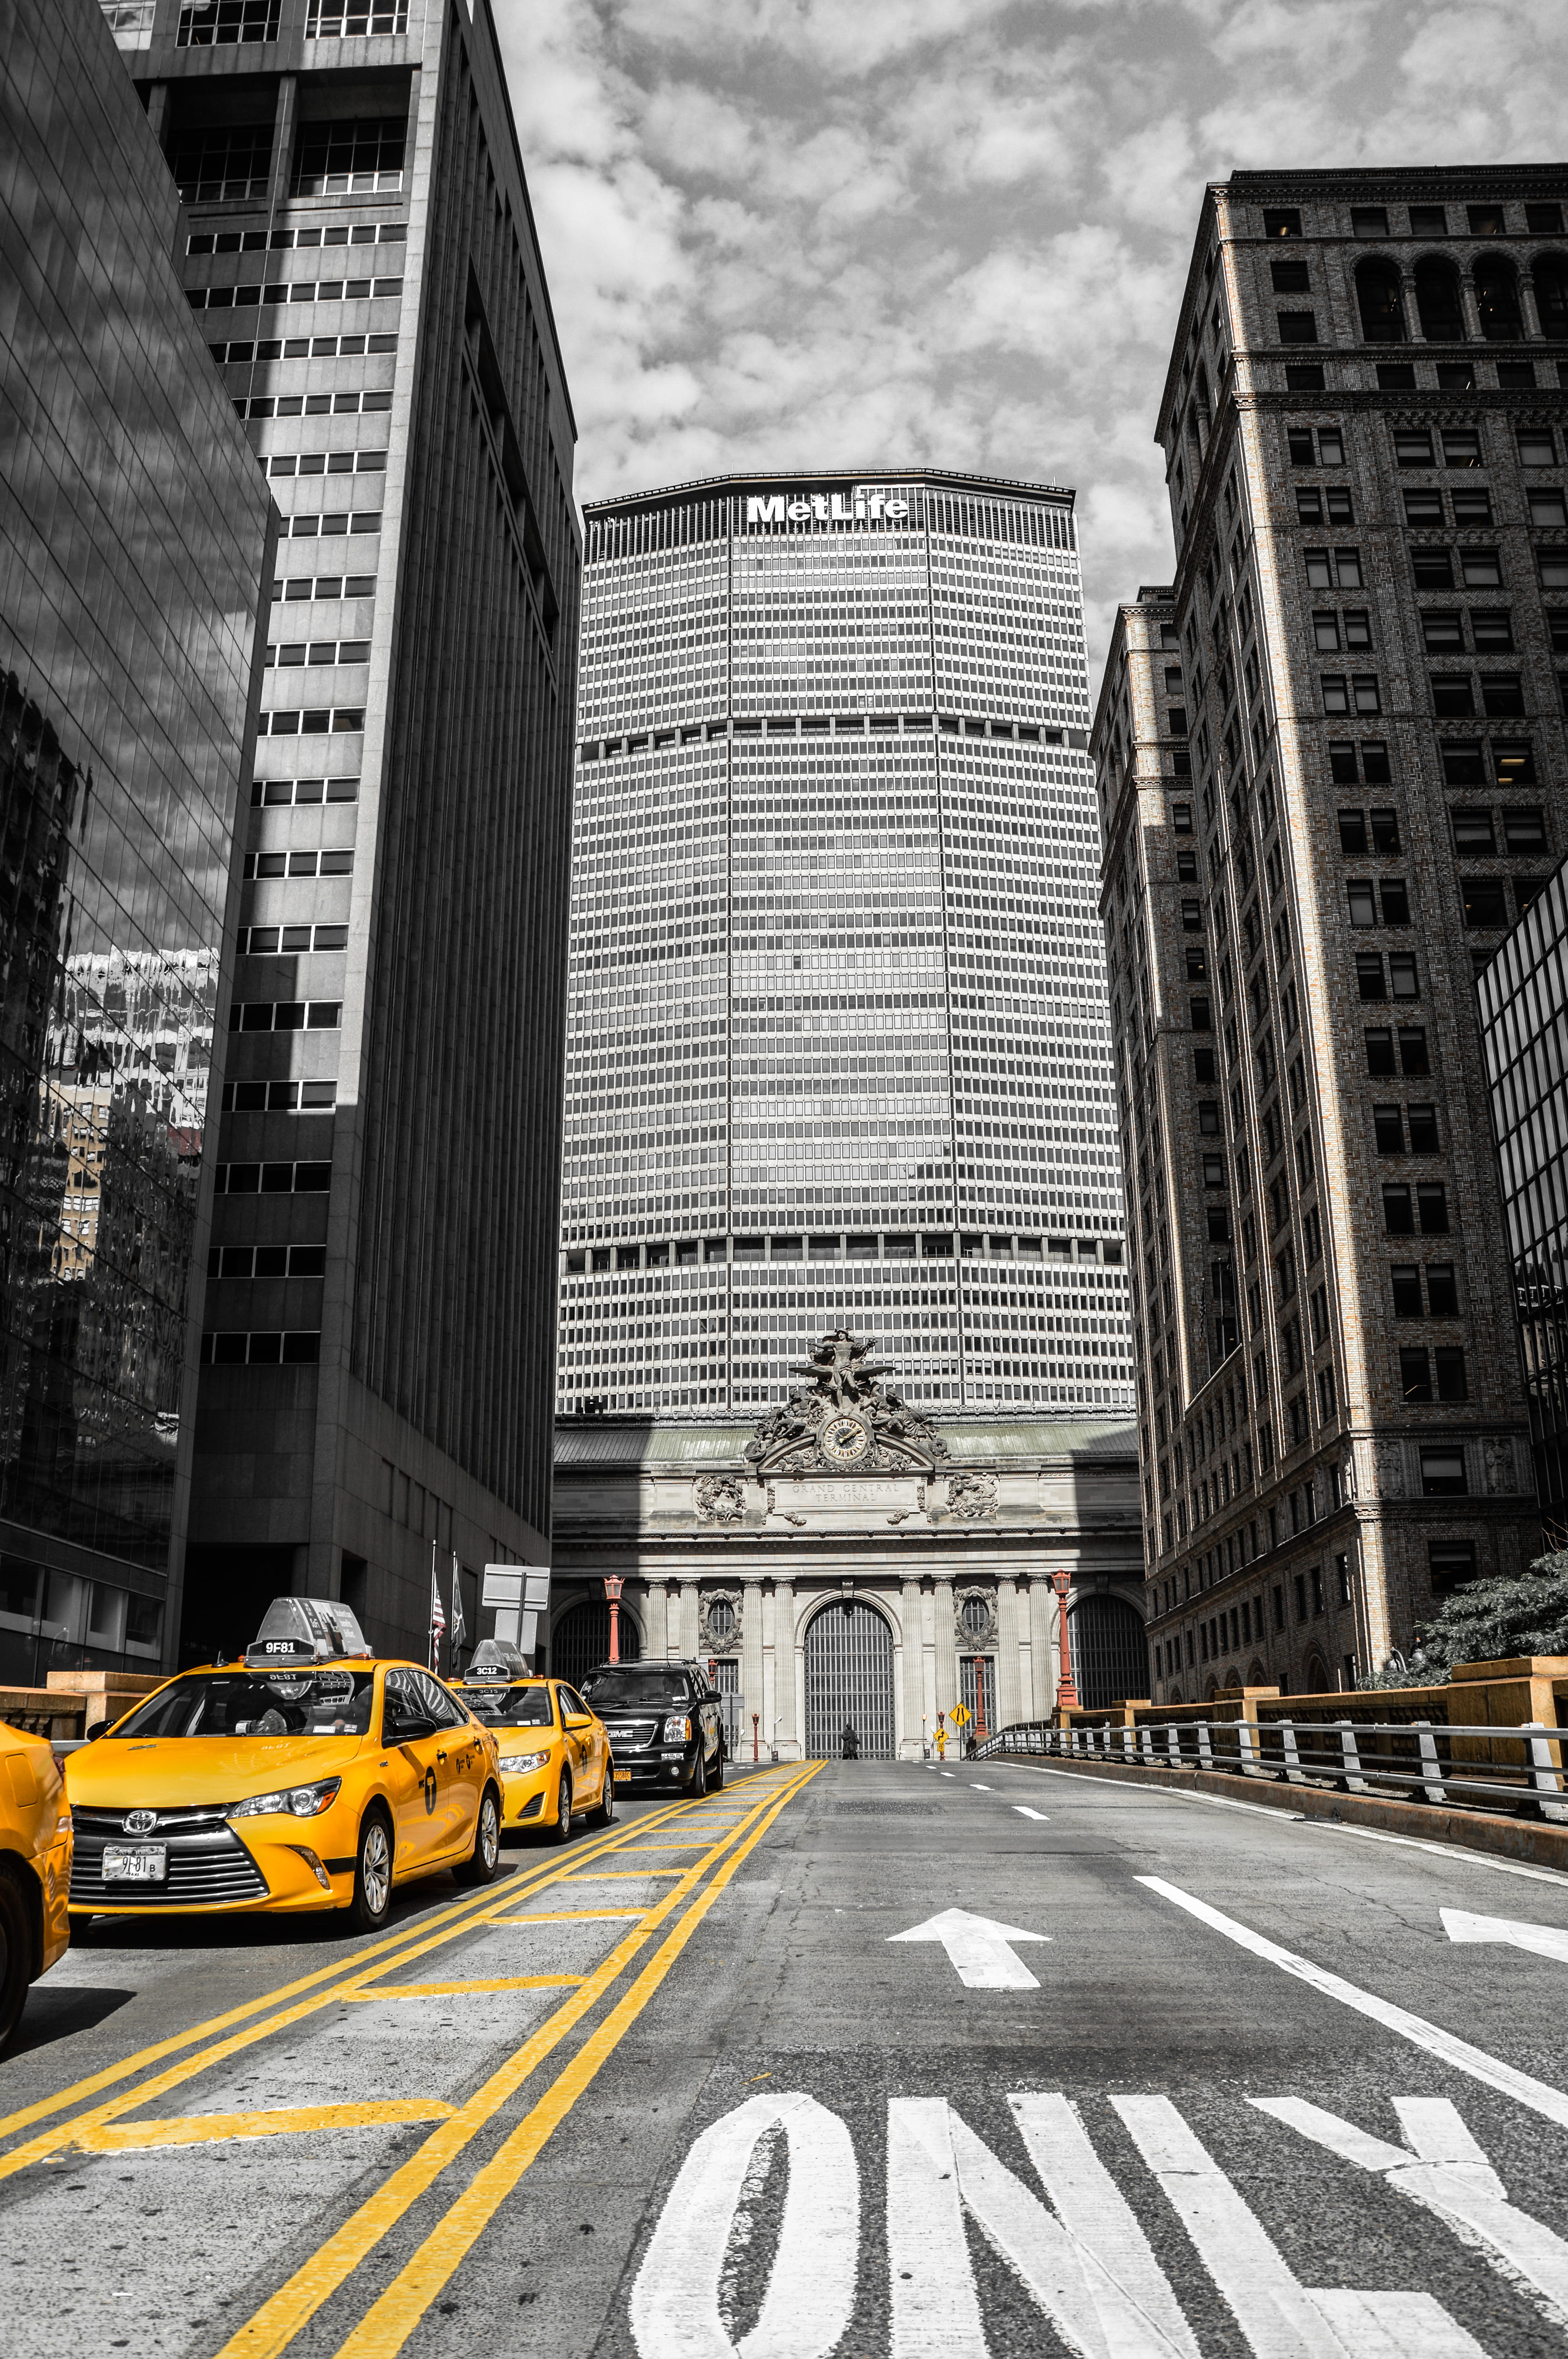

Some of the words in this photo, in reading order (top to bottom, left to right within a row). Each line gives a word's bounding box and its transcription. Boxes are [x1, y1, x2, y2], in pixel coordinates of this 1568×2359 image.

[748, 493, 908, 522] MetLife
[843, 1484, 899, 1492] CENTRAL
[266, 1642, 295, 1653] 9F81
[477, 1667, 497, 1675] 3C12
[628, 2092, 1568, 2359] ONLY
